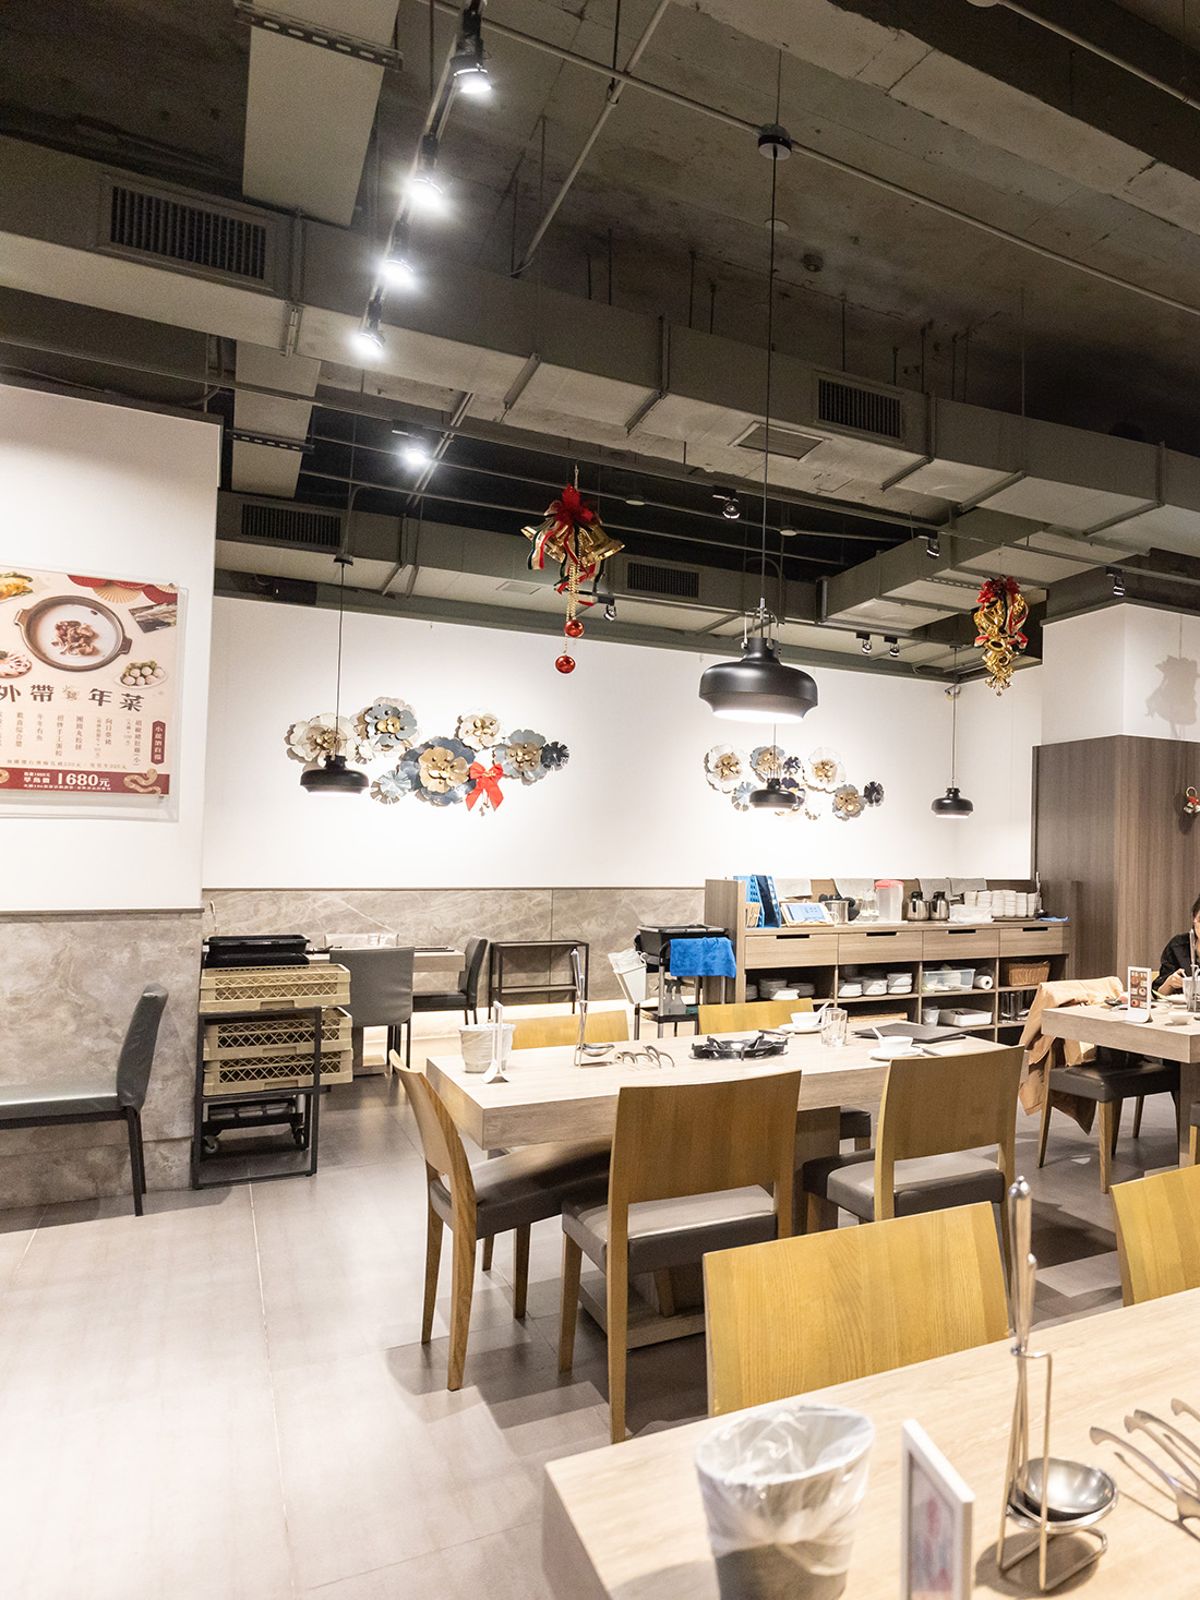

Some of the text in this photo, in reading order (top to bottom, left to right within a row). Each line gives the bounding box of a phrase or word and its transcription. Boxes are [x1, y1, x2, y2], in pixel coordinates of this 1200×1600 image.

[0, 685, 54, 703] 外帶
[88, 688, 145, 712] 年菜
[57, 772, 110, 787] 1680元
